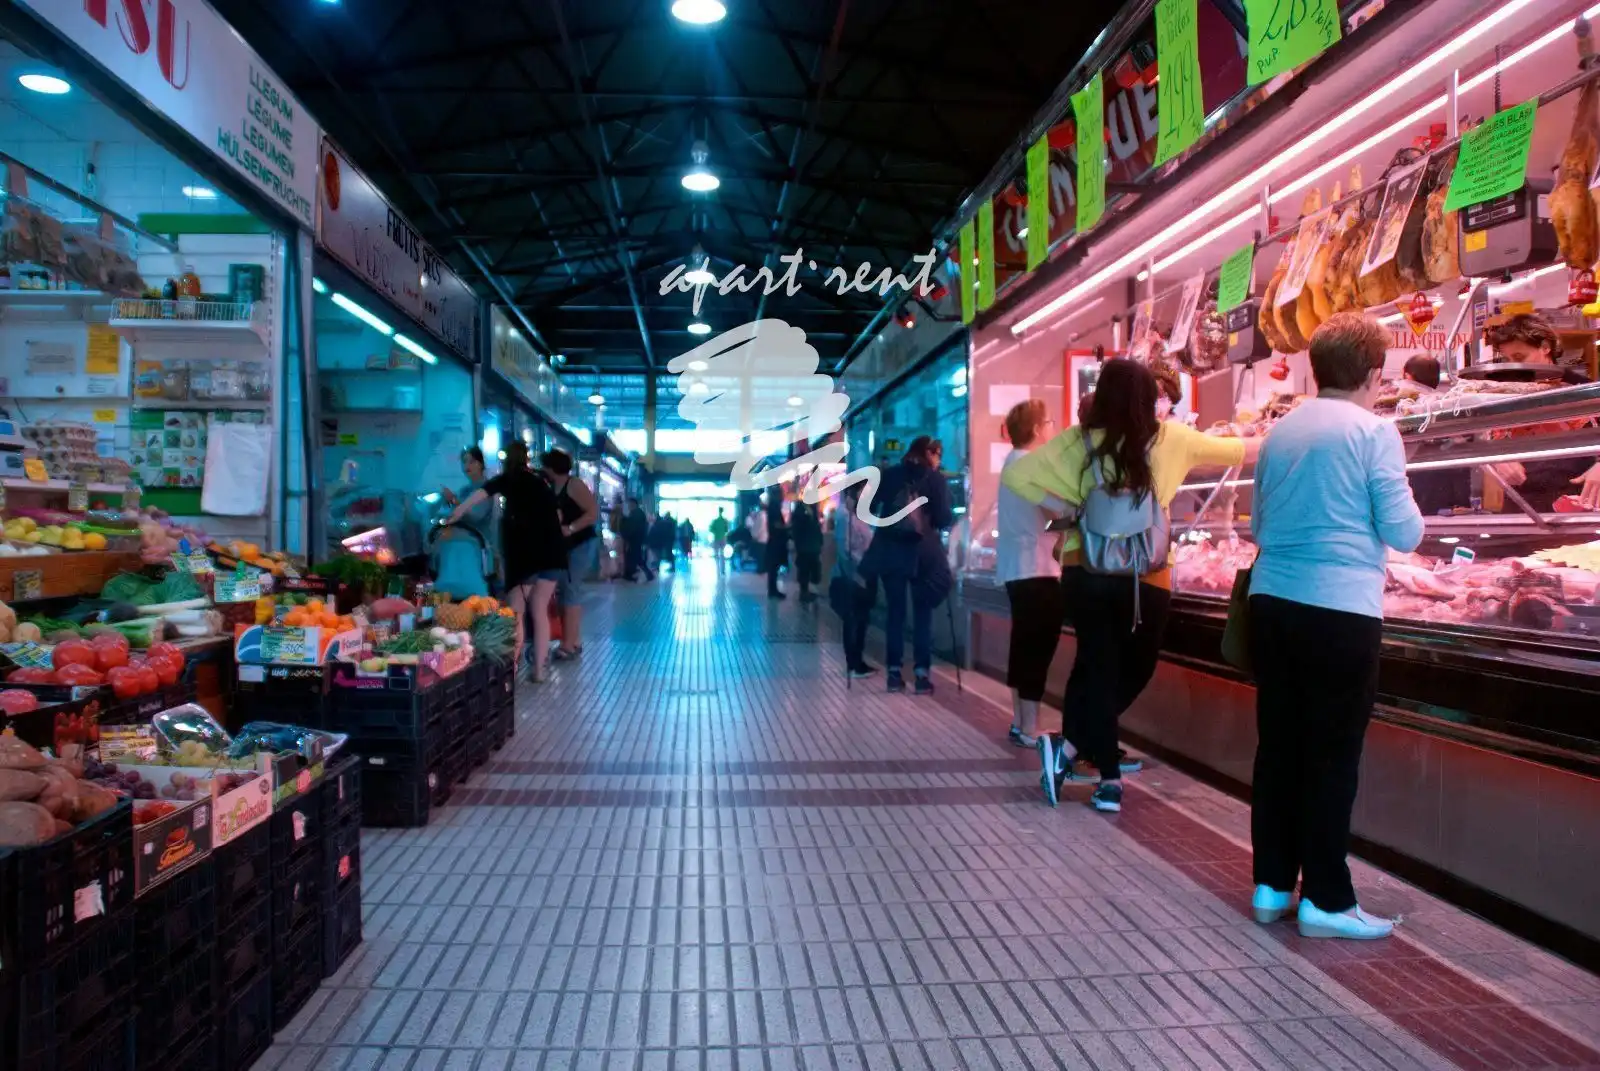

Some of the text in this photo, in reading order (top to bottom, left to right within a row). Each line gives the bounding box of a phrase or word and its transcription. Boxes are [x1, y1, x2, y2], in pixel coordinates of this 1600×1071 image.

[247, 93, 293, 150] LÉGUME
[249, 65, 293, 122] LLEGUM
[242, 119, 295, 179] LEGUMEN
